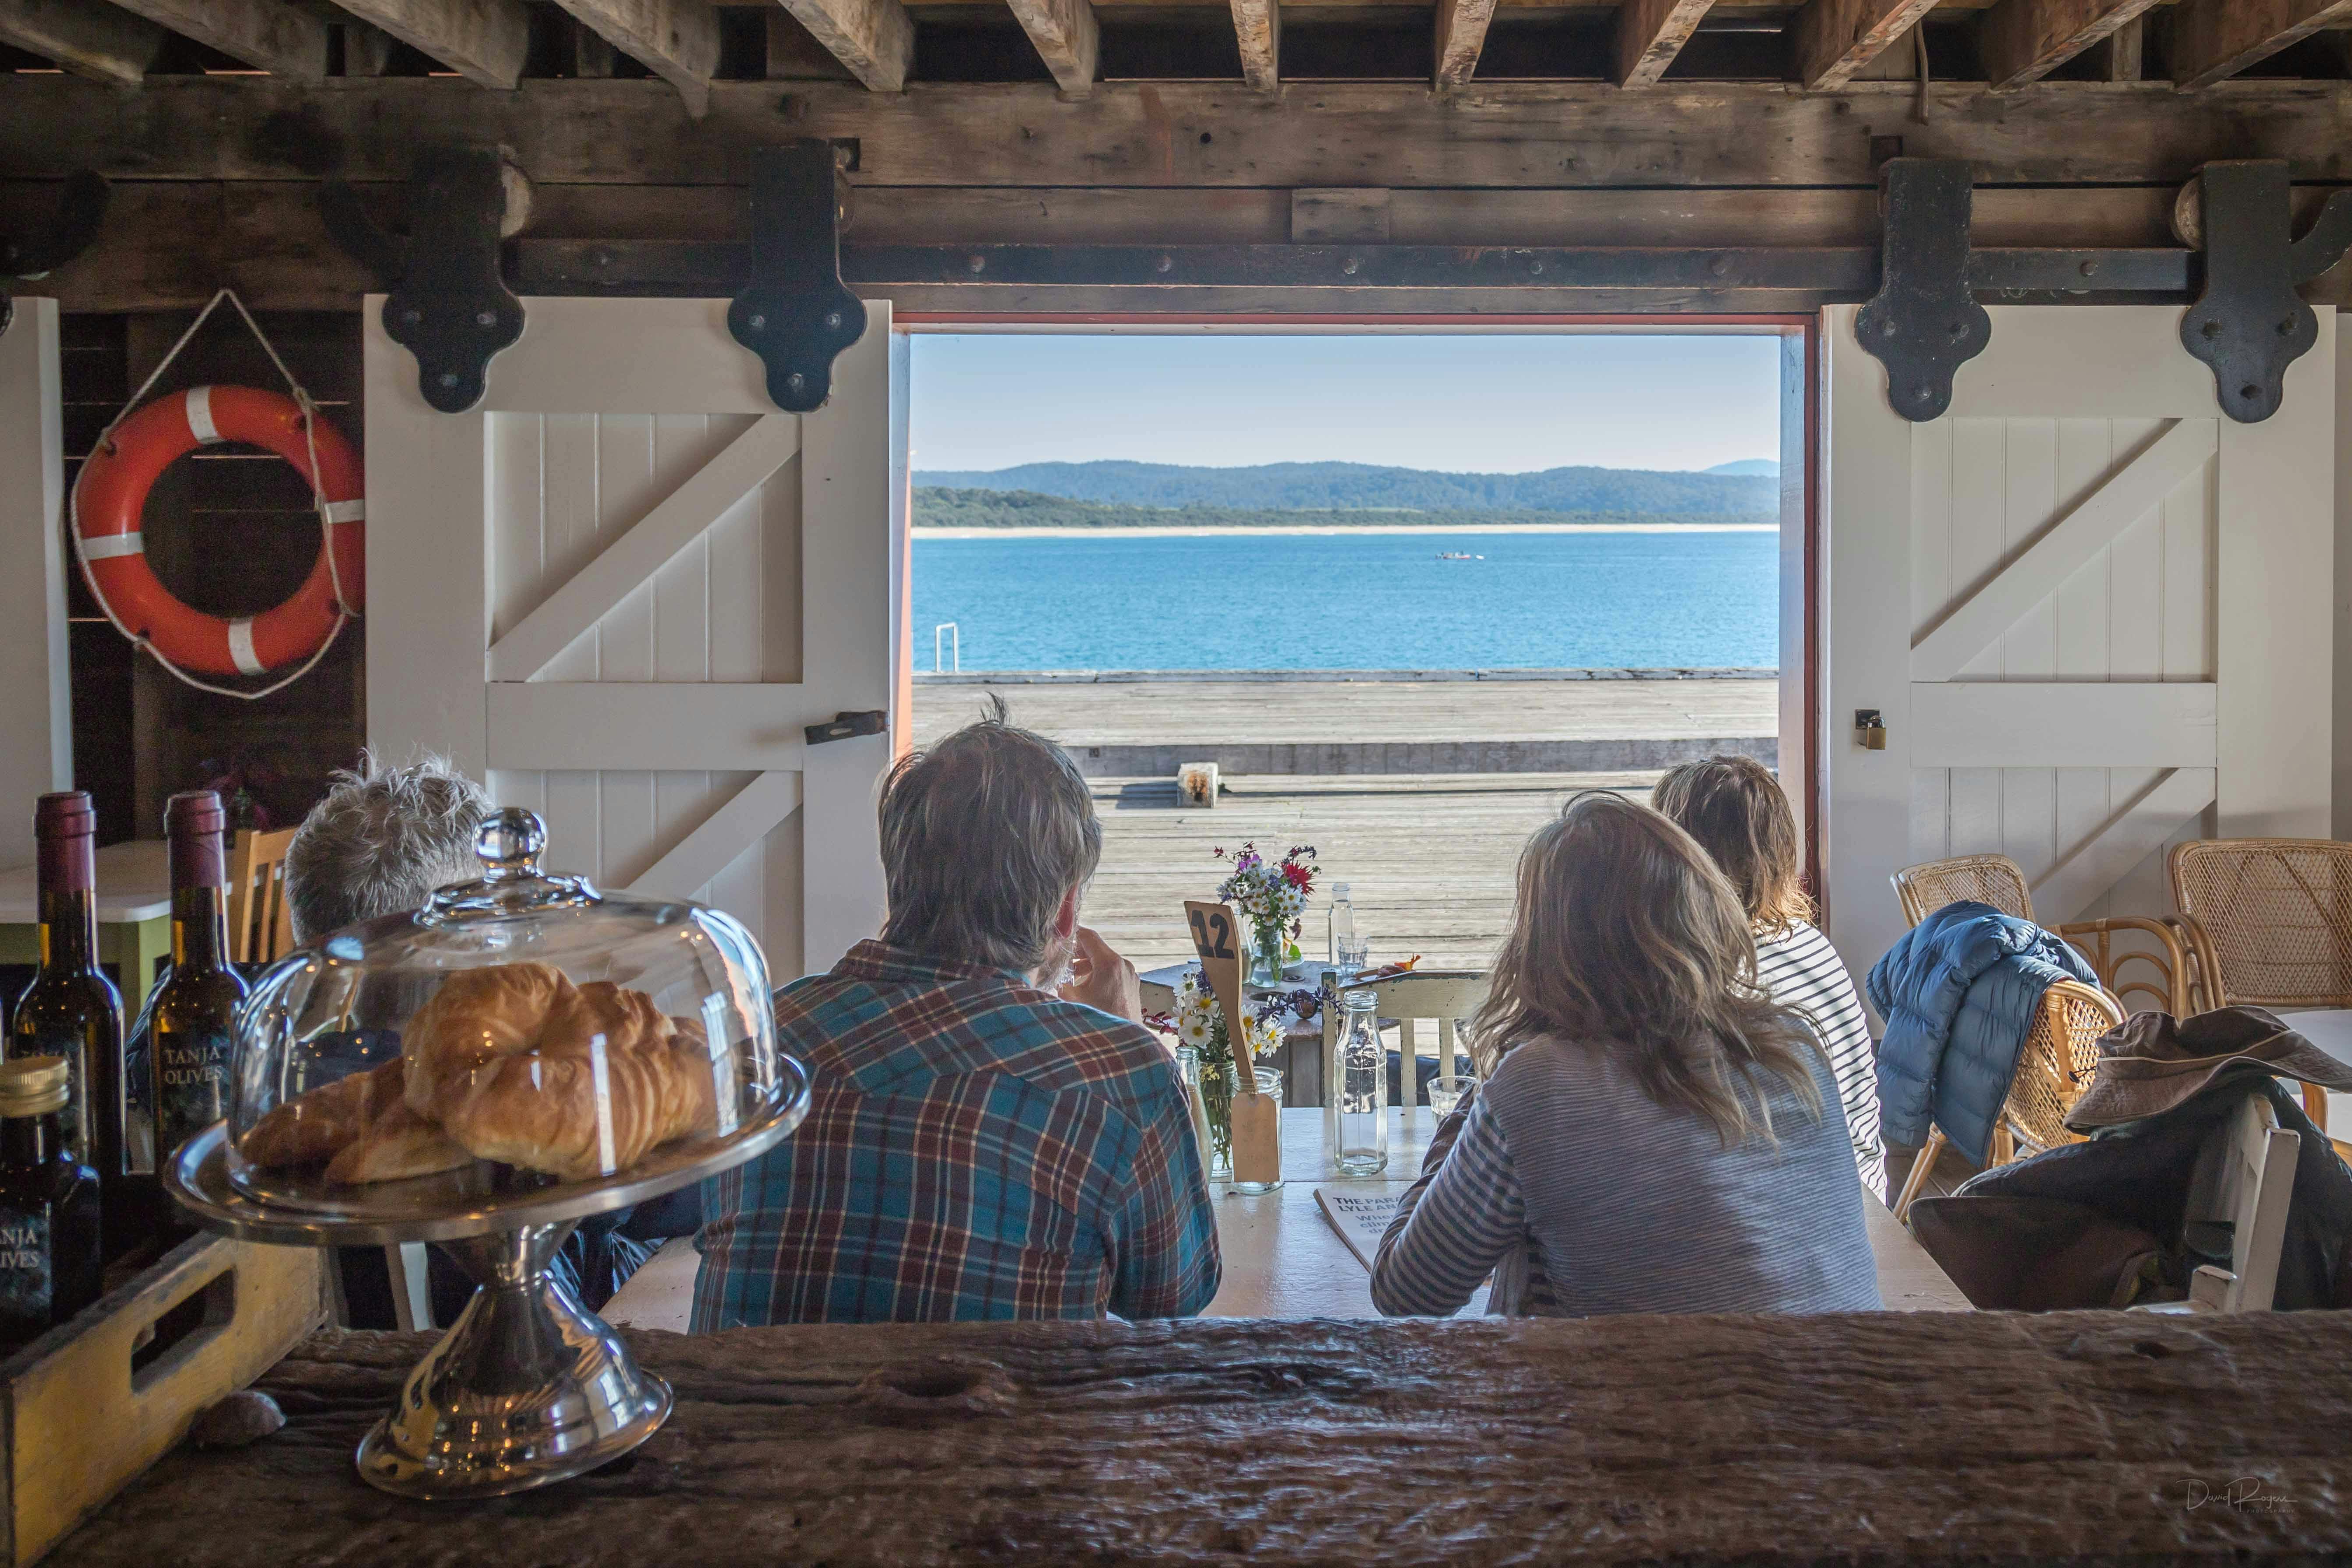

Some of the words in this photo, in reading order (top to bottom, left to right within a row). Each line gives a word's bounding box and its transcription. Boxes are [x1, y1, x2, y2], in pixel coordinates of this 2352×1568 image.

[1191, 910, 1235, 959] 12
[164, 1046, 221, 1065] TANJA
[164, 1065, 223, 1084] OLIVES
[0, 1228, 38, 1249] NJA
[0, 1251, 39, 1268] IVES
